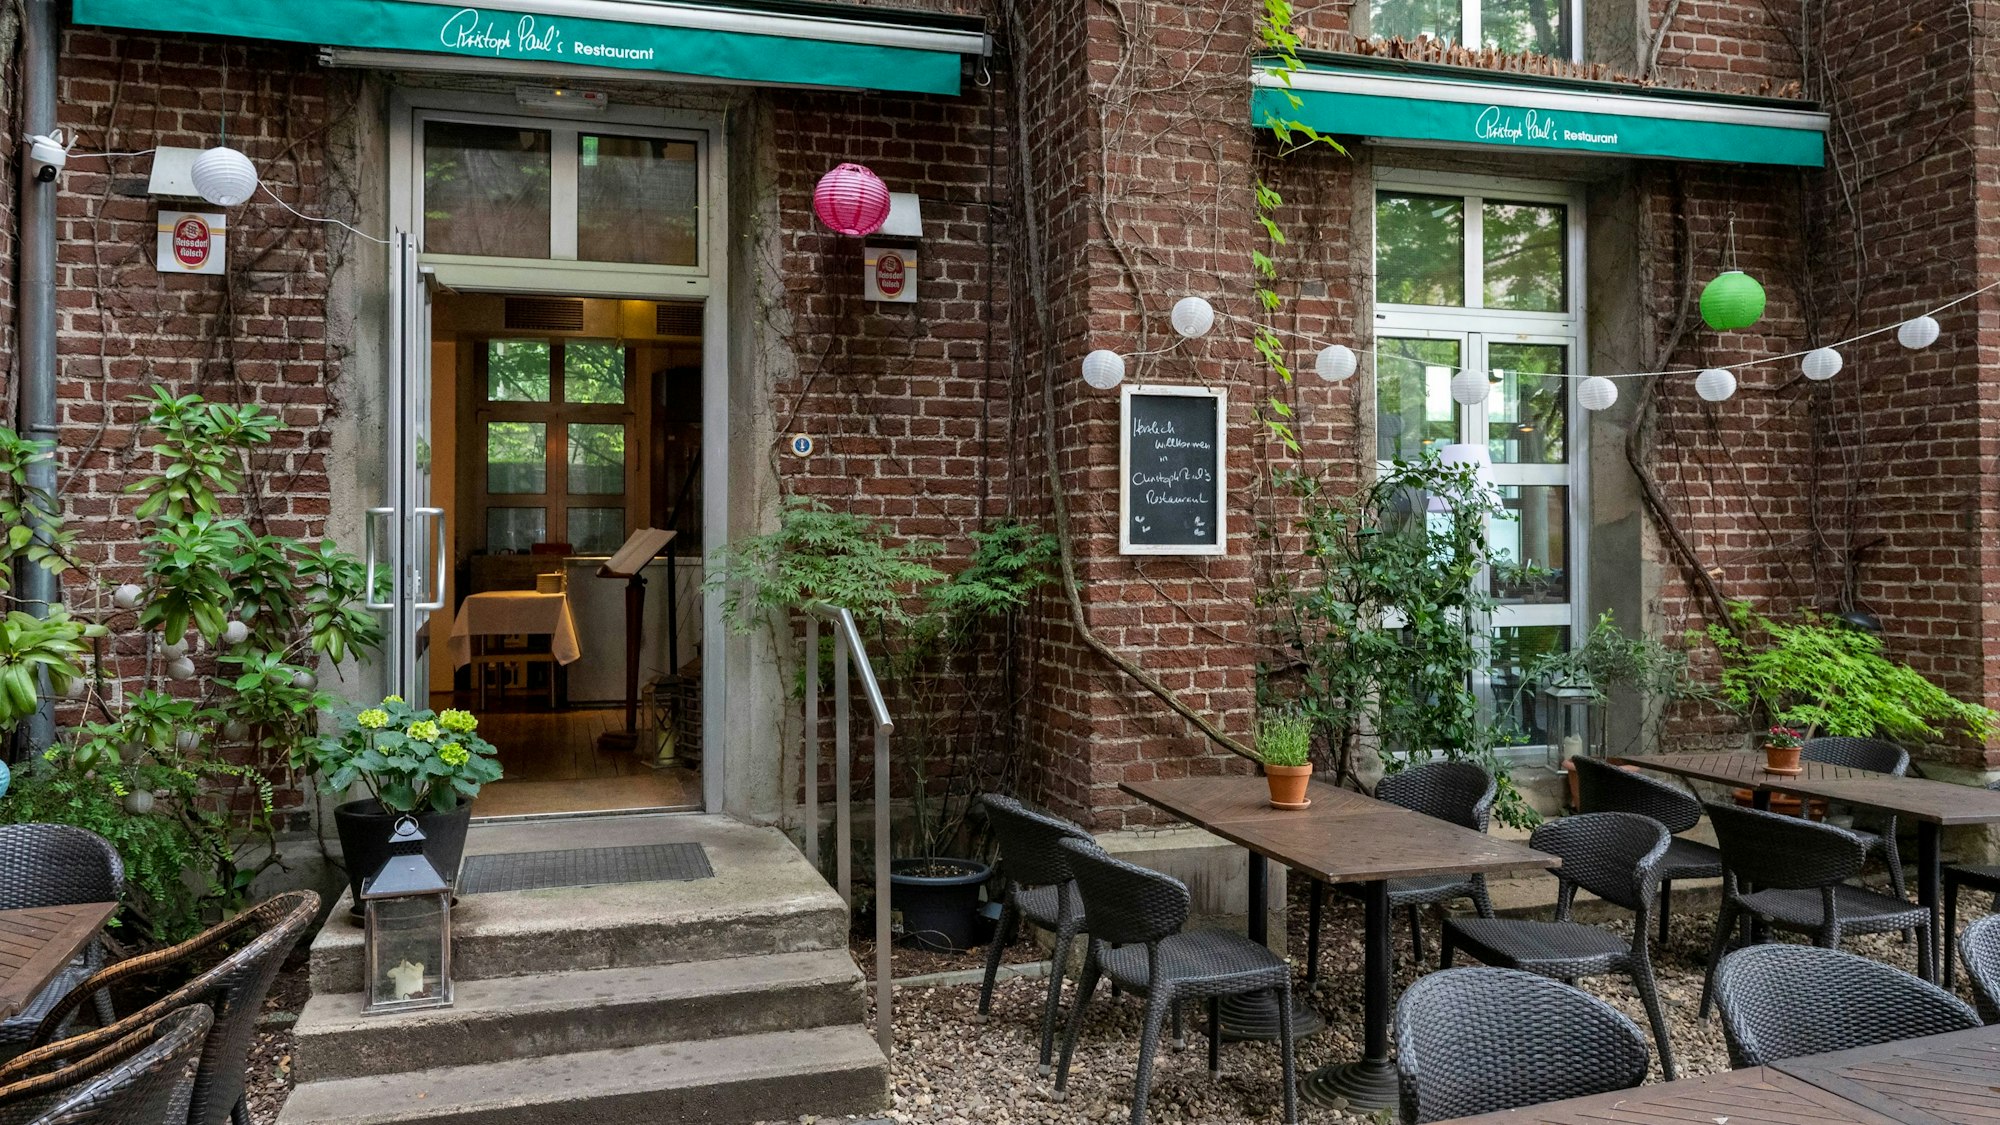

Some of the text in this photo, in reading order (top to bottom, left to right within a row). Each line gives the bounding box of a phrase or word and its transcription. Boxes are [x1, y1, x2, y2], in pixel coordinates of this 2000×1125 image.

[518, 15, 563, 54] Paul's
[574, 41, 654, 60] Restaurant
[1525, 109, 1557, 141] Paul's
[1563, 129, 1618, 144] Restaurant
[175, 237, 208, 248] Reissdorf
